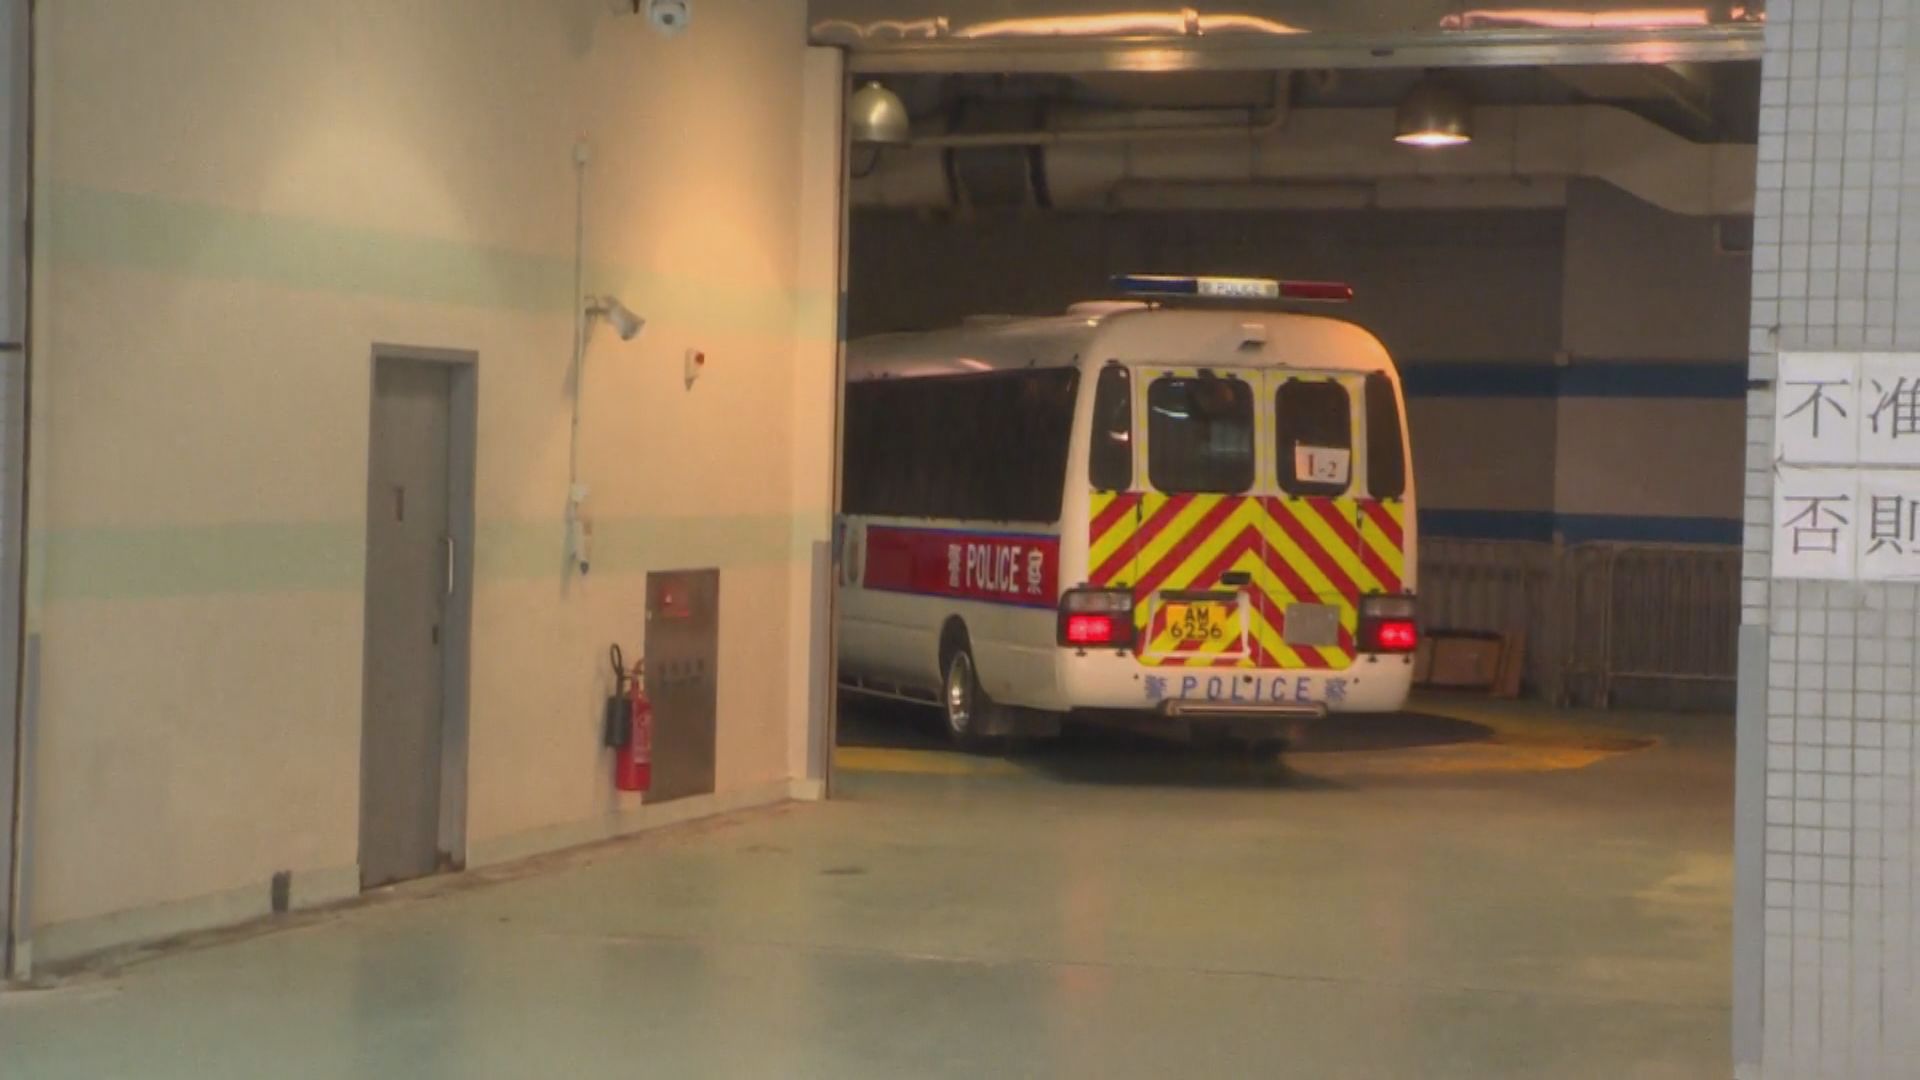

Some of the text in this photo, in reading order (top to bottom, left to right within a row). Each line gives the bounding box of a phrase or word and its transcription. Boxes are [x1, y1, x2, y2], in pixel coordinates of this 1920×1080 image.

[1784, 377, 1920, 439] 不准
[1782, 495, 1920, 555] 否則
[966, 543, 1021, 593] POLICE
[1170, 621, 1223, 639] 6256
[1185, 607, 1209, 624] AM
[1181, 676, 1311, 701] POLICE
